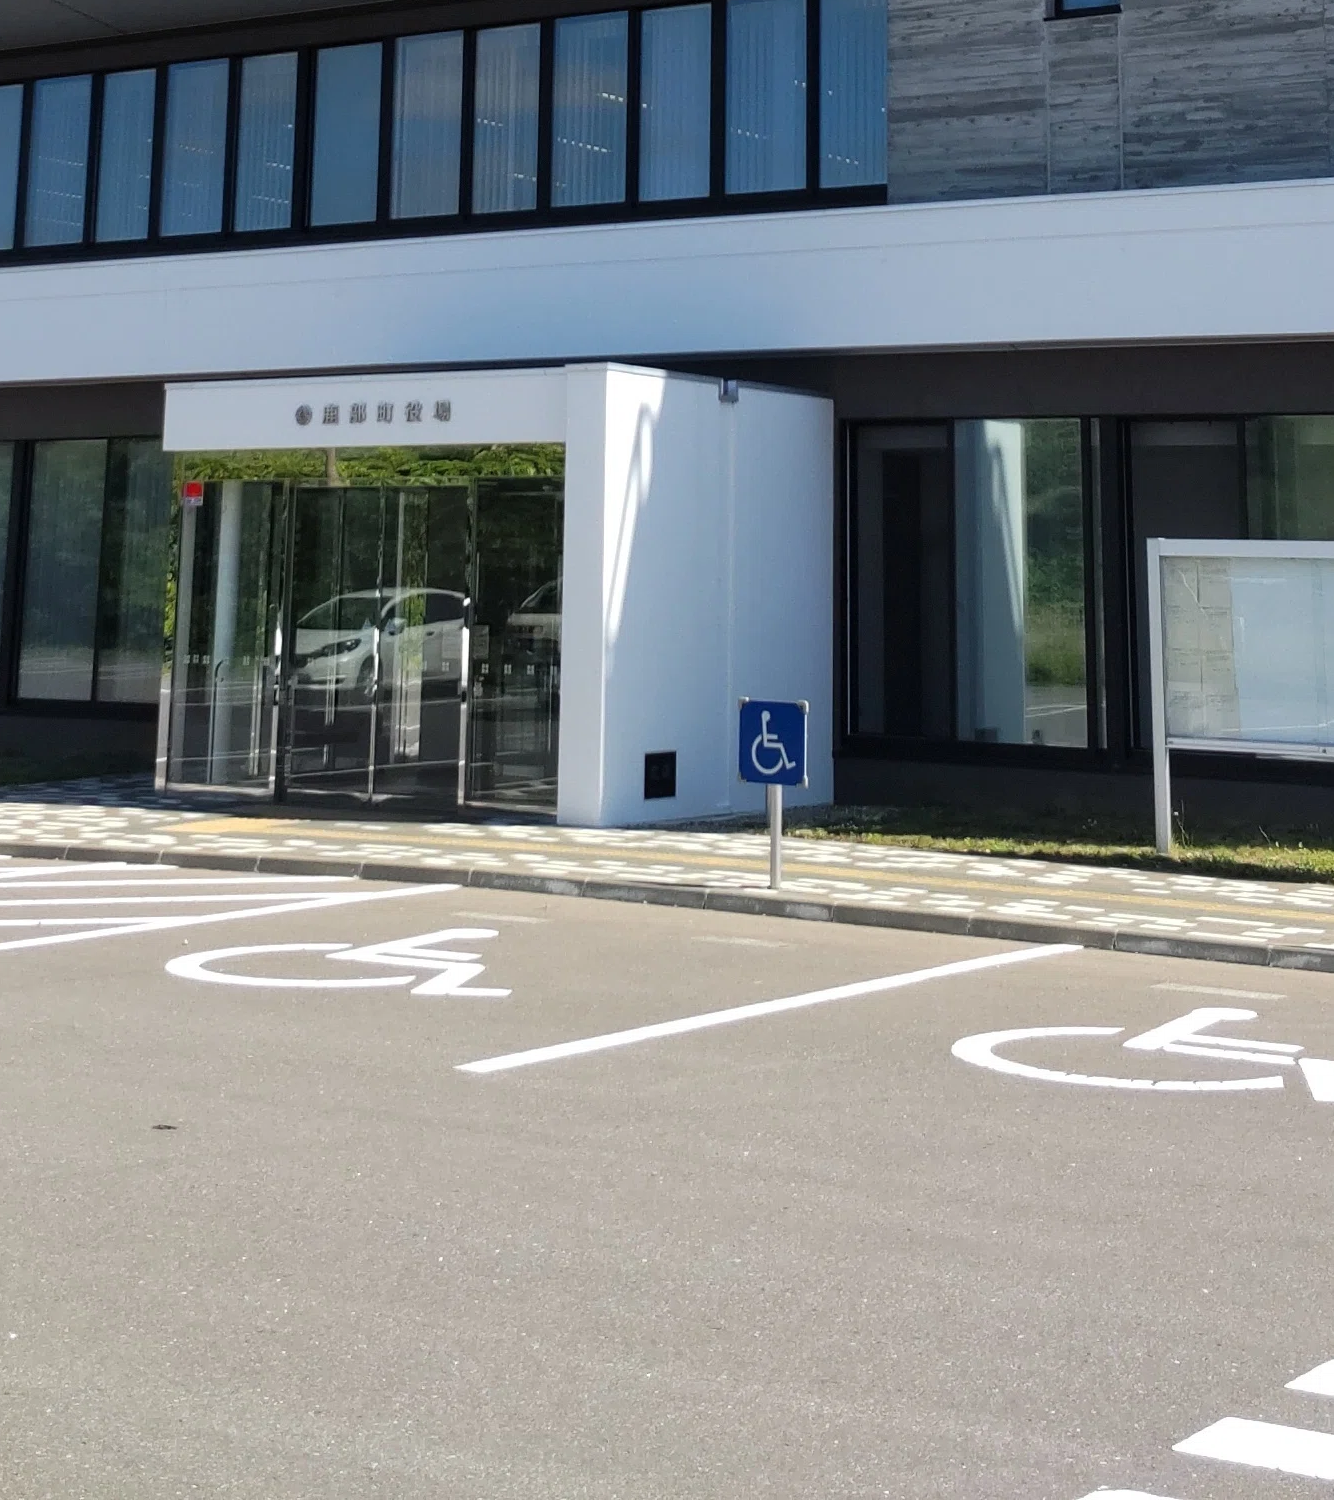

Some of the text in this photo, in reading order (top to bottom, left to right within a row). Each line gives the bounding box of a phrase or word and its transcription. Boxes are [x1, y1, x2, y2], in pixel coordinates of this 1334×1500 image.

[322, 400, 452, 425] 鹿部町役場
